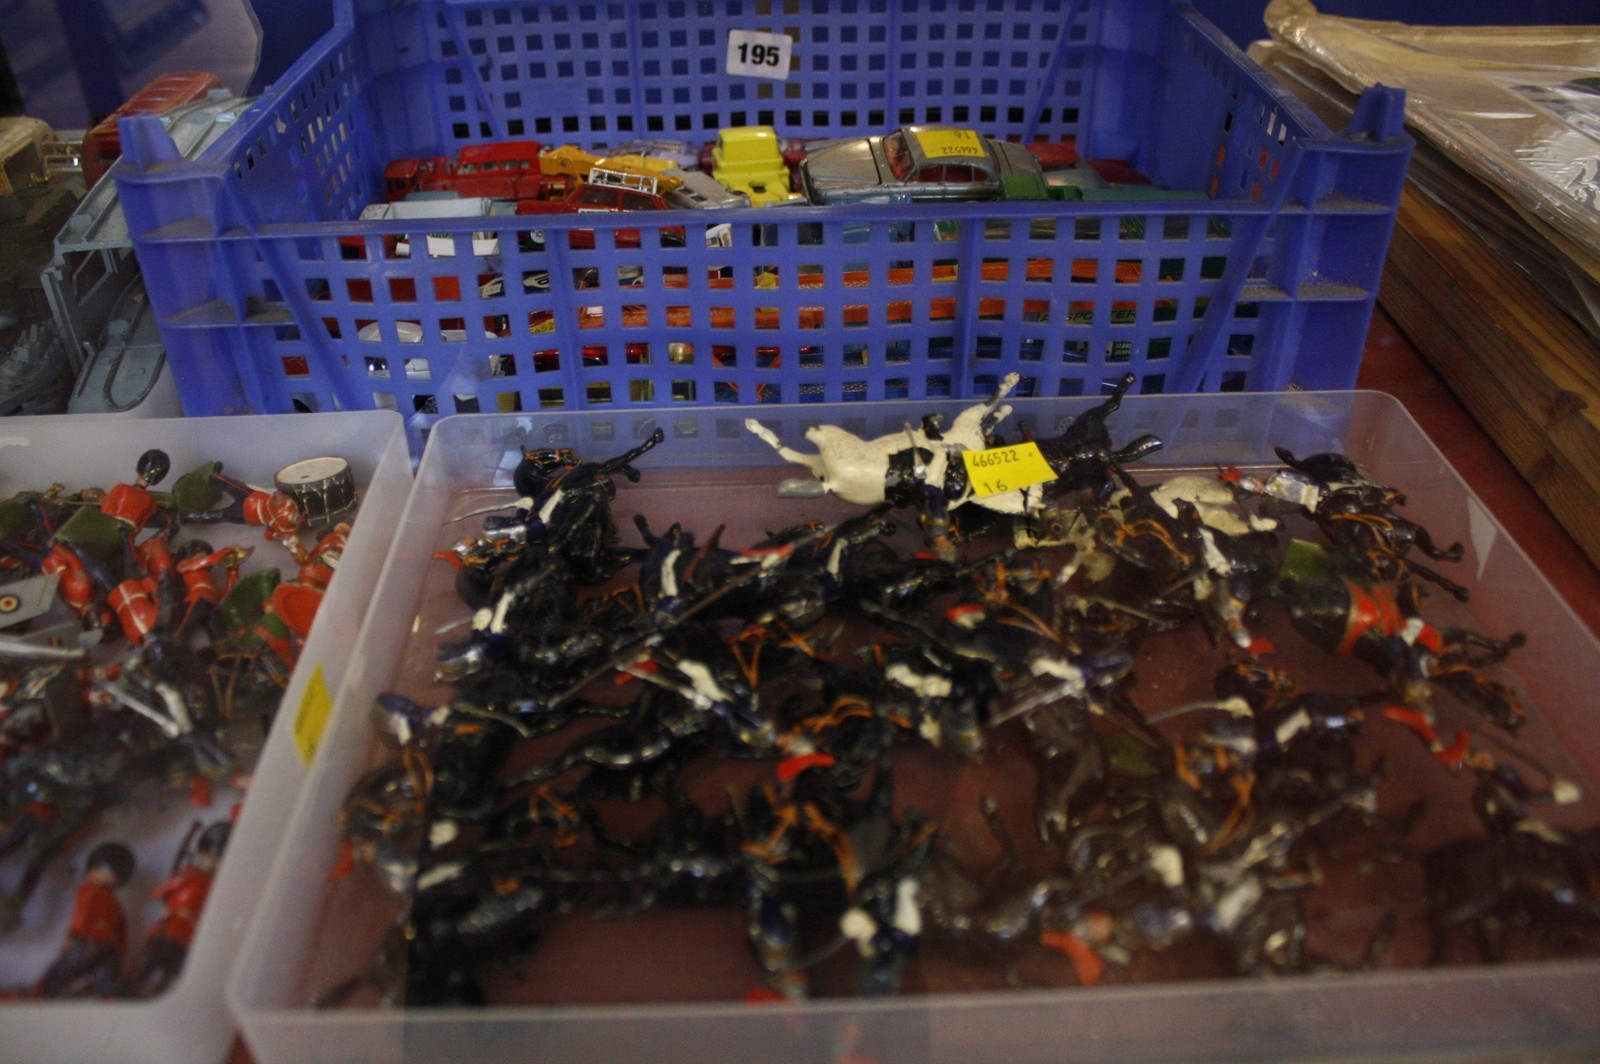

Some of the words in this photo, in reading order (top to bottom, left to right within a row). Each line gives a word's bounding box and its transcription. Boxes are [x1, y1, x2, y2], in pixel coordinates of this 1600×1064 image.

[737, 42, 780, 67] 195
[972, 449, 1020, 468] 466522
[983, 479, 1008, 494] 16
